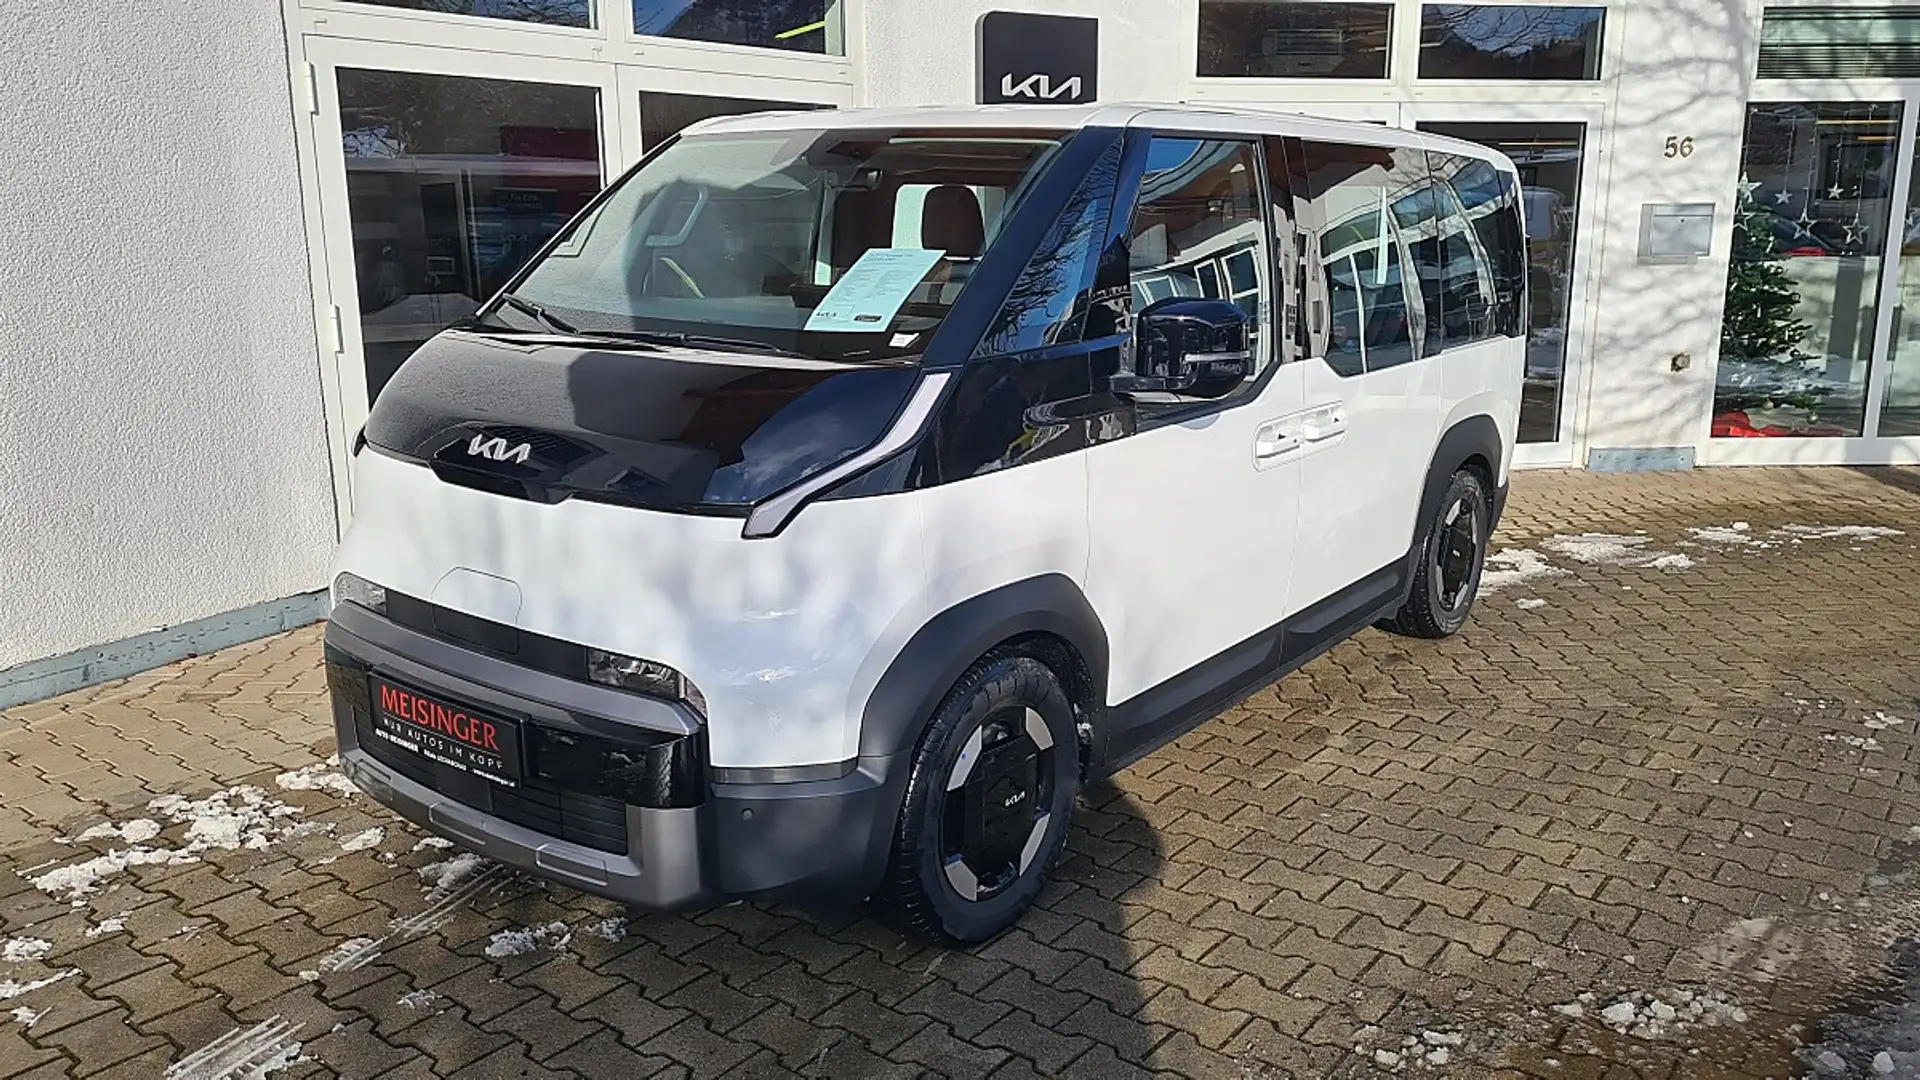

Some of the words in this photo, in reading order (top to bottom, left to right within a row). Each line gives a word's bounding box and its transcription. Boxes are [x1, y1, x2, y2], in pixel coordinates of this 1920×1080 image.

[1002, 72, 1081, 100] KIA
[1664, 136, 1694, 158] 56
[467, 433, 532, 465] KIA
[381, 684, 500, 752] MEISINGER
[408, 729, 443, 750] AUTOS
[450, 744, 462, 757] IM
[469, 751, 503, 769] KOPF
[1004, 790, 1026, 808] KIA
